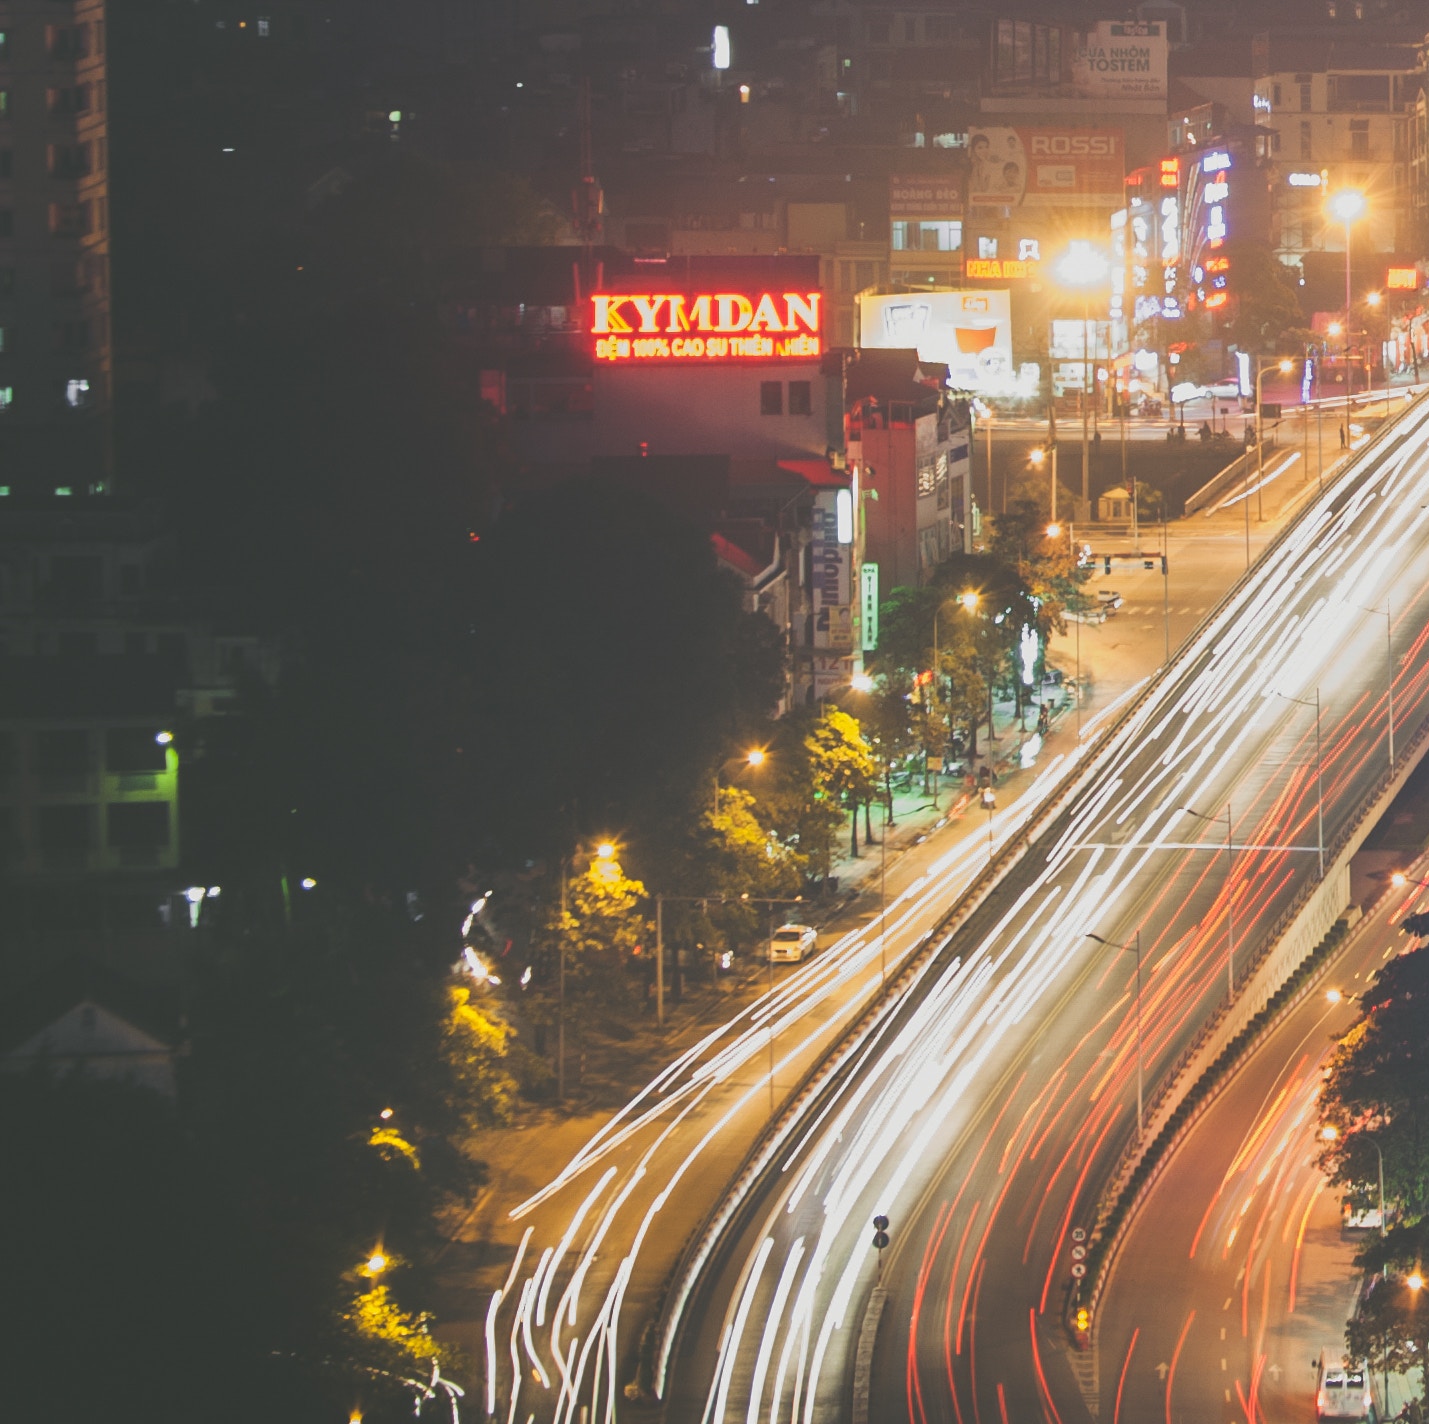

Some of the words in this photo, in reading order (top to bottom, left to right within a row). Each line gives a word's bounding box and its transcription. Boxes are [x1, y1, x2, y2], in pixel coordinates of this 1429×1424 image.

[1088, 58, 1150, 72] TOSTEM
[1031, 135, 1115, 155] ROSSI
[592, 293, 821, 334] KYMDAN
[632, 337, 670, 358] 100%
[671, 337, 705, 358] CAO
[706, 337, 728, 358] SU
[729, 334, 774, 358] THIÊN
[776, 333, 819, 358] NHIÊN
